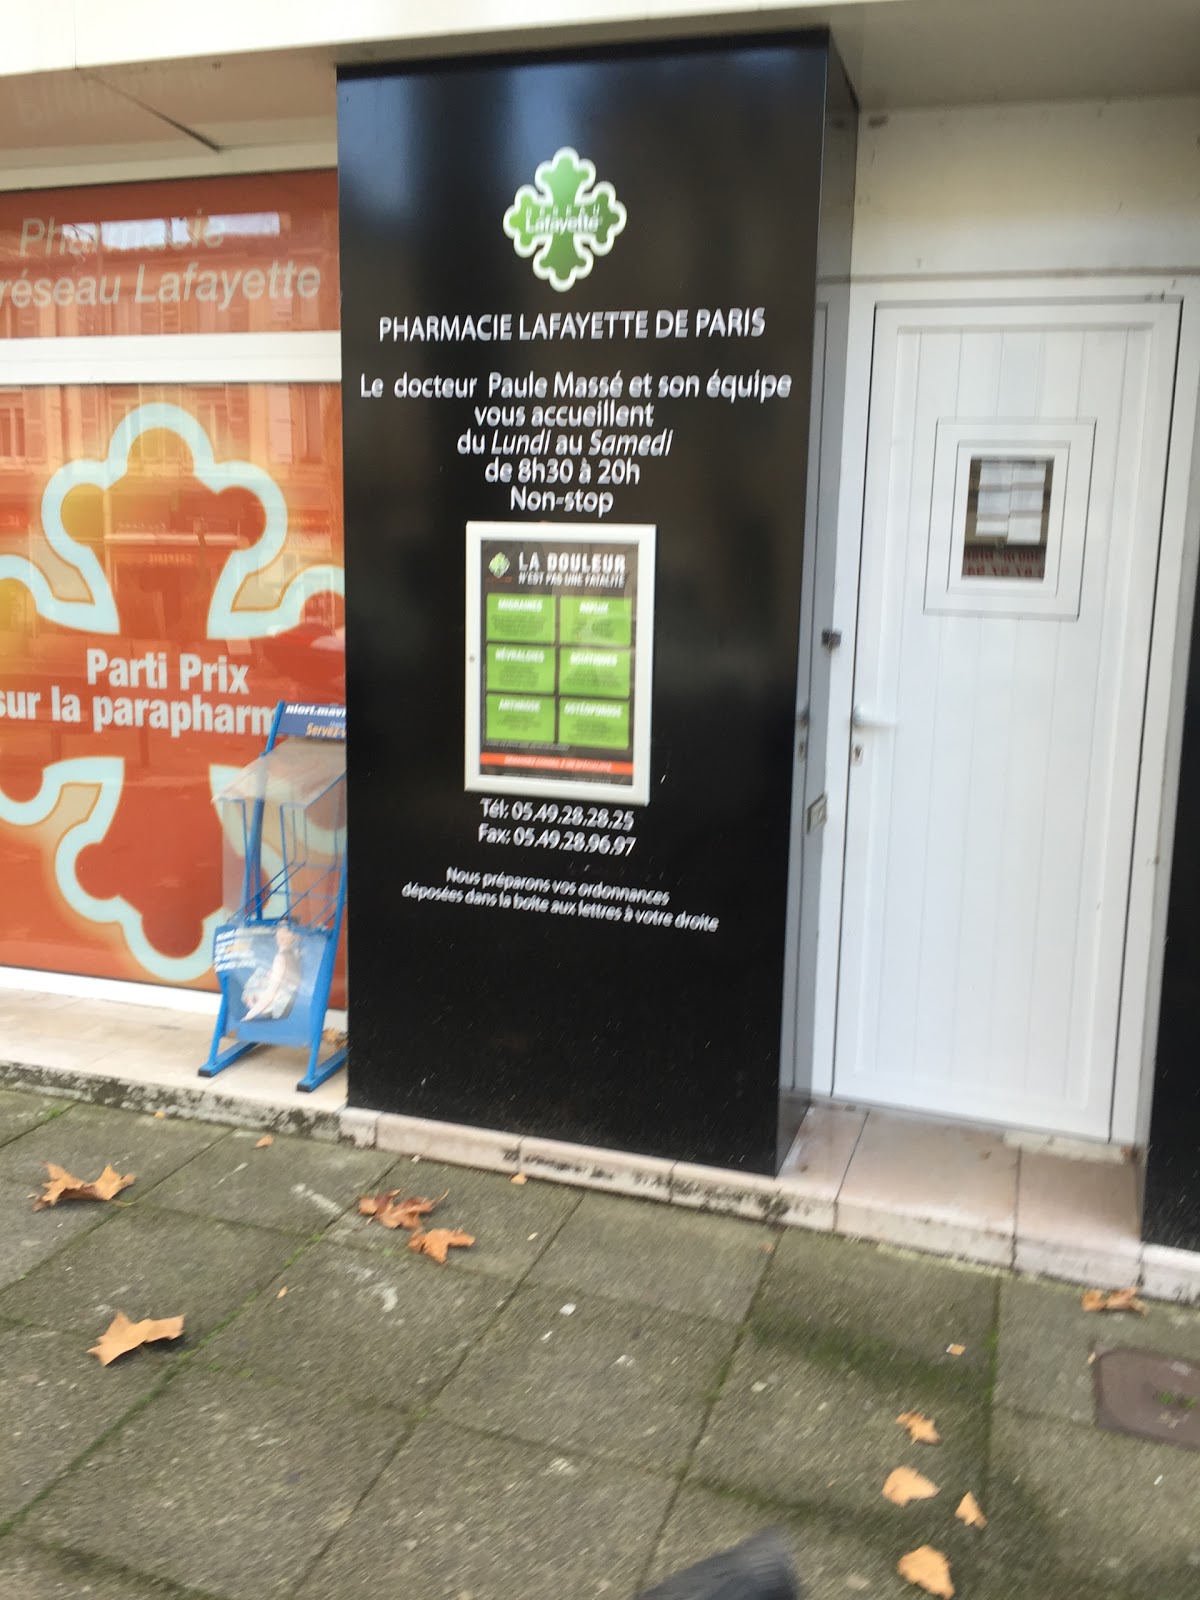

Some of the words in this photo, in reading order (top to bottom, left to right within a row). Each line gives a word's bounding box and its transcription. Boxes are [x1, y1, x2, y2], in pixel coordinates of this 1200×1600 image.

[525, 209, 602, 236] Lafayette
[0, 270, 120, 308] réseau
[135, 261, 320, 311] Lafayette
[379, 315, 512, 341] PHARMACIE
[519, 311, 649, 340] LAFAYETTE
[655, 309, 688, 338] DE
[695, 307, 766, 337] PARIS
[360, 373, 384, 398] Le
[394, 374, 477, 398] docteur
[488, 372, 548, 398] Paule
[553, 370, 622, 397] Massé
[628, 375, 652, 397] et
[658, 374, 700, 397] son
[706, 370, 793, 403] équipe
[474, 405, 526, 427] vous
[531, 401, 654, 427] accueillent
[457, 430, 485, 455] du
[491, 430, 551, 455] Lundi
[555, 434, 583, 456] au
[589, 429, 673, 456] Samedi
[485, 458, 513, 482] de
[518, 458, 574, 484] 8h30
[579, 458, 591, 484] à
[597, 460, 640, 485] 20h
[510, 486, 614, 517] Non-stop
[518, 552, 541, 571] LA
[547, 552, 626, 574] DOULEUR
[87, 648, 167, 689] Parti
[179, 653, 249, 695] Prix
[0, 690, 41, 720] sur
[51, 685, 81, 723] la
[92, 694, 276, 736] parapharm
[480, 797, 508, 819] Tél:
[511, 800, 635, 832] 05.49.28.28.25
[478, 823, 511, 845] Fax:
[513, 826, 637, 856] 05.49.28.96.97
[446, 866, 481, 885] Nous
[482, 871, 550, 893] préparons
[551, 880, 576, 895] vos
[577, 881, 670, 906] ordonnances
[401, 882, 463, 902] déposées
[464, 888, 497, 907] dans
[498, 890, 511, 908] la
[550, 899, 577, 915] aux
[577, 899, 622, 921] lettres
[623, 904, 634, 922] à
[634, 909, 673, 927] votre
[674, 910, 720, 932] droite
